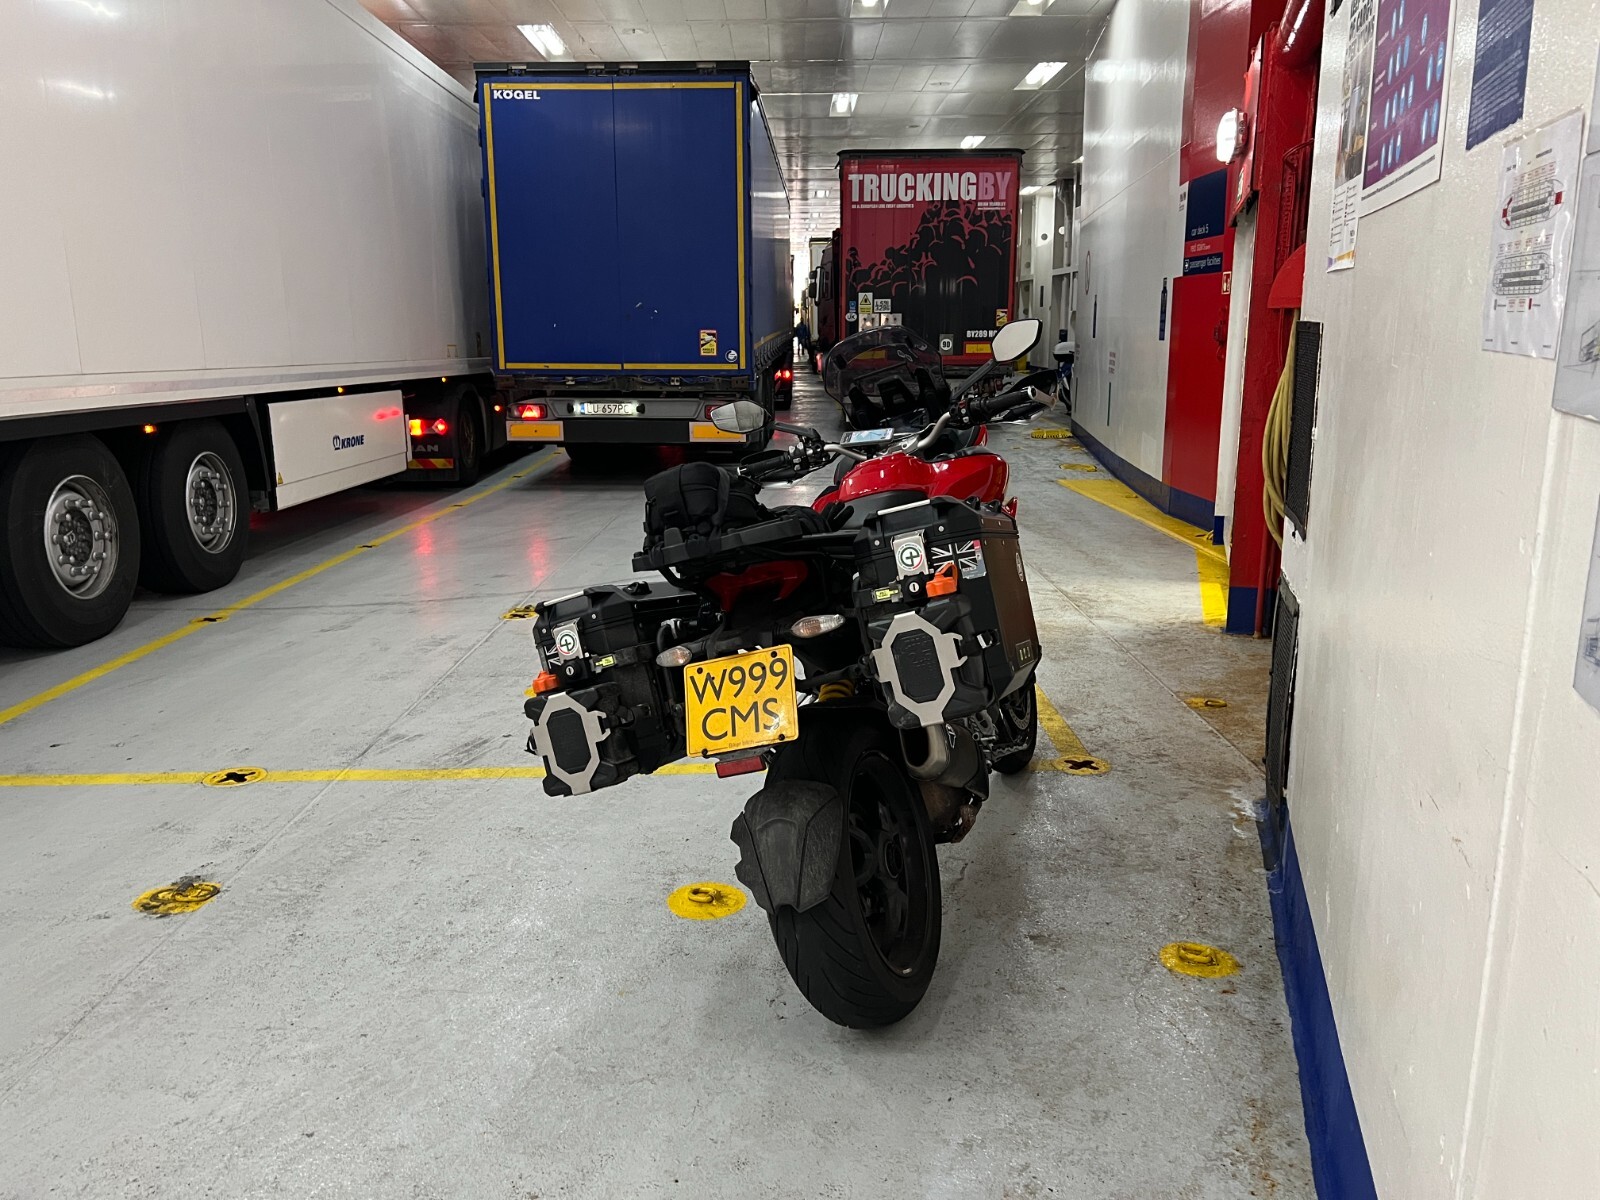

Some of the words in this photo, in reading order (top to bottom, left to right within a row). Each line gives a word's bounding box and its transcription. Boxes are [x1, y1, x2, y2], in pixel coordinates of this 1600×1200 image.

[493, 89, 541, 100] KÖGEL
[601, 404, 630, 414] 657PC
[341, 435, 365, 449] KRONE
[412, 444, 439, 453] AN
[689, 657, 788, 705] W999
[701, 697, 780, 741] CMS
